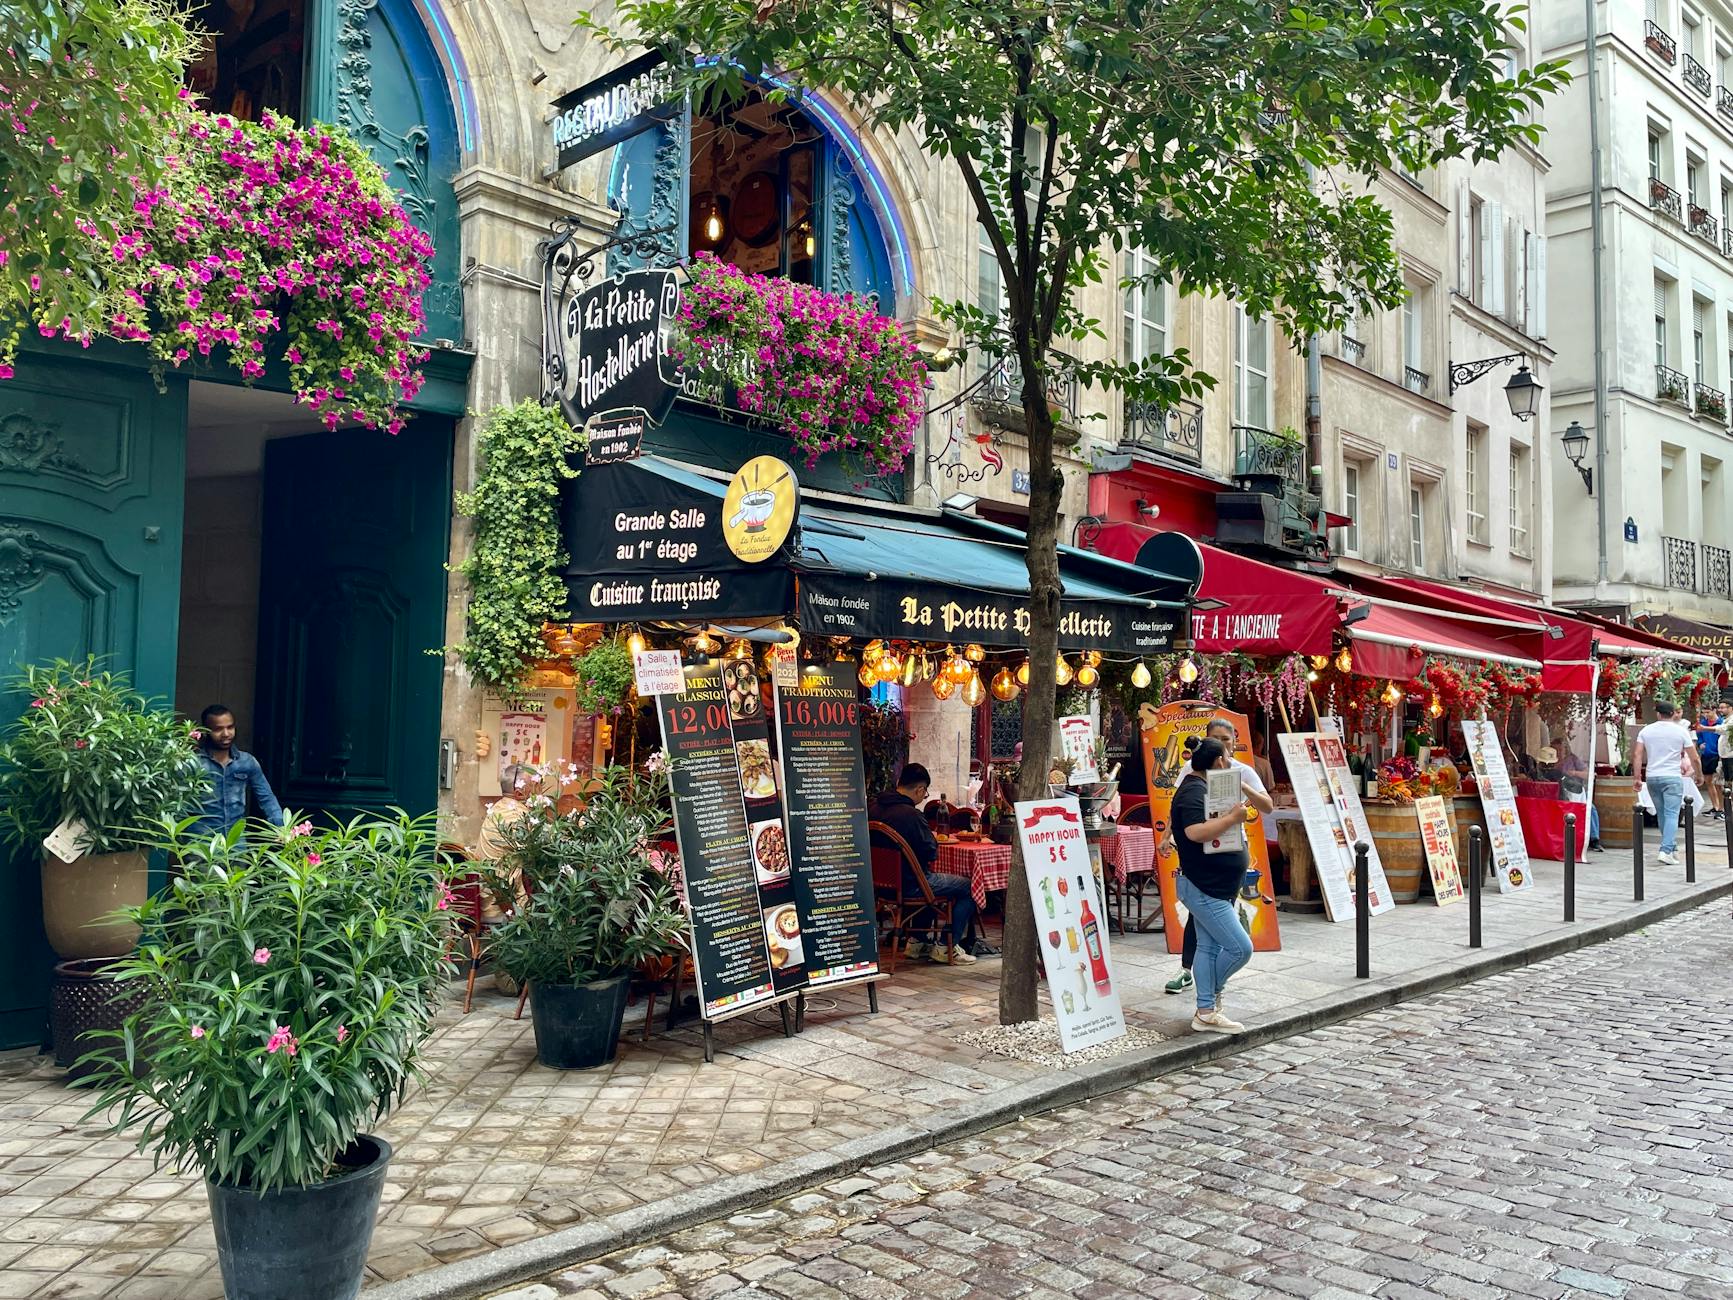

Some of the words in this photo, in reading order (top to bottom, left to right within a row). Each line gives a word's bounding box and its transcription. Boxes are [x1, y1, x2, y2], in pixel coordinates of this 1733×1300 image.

[583, 294, 603, 331] La
[605, 285, 655, 329] Petite
[579, 330, 655, 409] Hostellerie
[590, 428, 616, 441] Maison
[601, 446, 610, 454] en
[611, 441, 628, 453] 1902
[615, 511, 665, 532] Grande
[669, 508, 705, 529] Salle
[616, 543, 634, 560] au
[638, 540, 653, 560] 1er
[657, 539, 697, 563] étage
[590, 580, 644, 607] Cuisine
[650, 575, 721, 609] française
[809, 592, 839, 607] Maison
[841, 596, 870, 610] fondée
[824, 614, 834, 623] en
[836, 613, 855, 626] 1902
[900, 596, 933, 625] La
[940, 601, 1008, 632] Petite
[1013, 607, 1111, 637] Hellerie
[1131, 621, 1151, 631] Cuisine
[1152, 621, 1173, 632] française
[1212, 614, 1219, 639] A
[1226, 614, 1282, 639] L'ANCIENNE
[648, 653, 668, 663] Salle
[639, 667, 679, 678] climatisée
[644, 682, 649, 691] à
[651, 680, 678, 692] l'étage
[686, 677, 720, 689] MENU
[803, 675, 834, 686] MENU
[676, 690, 727, 702] CLASSIQU
[781, 687, 856, 698] TRADITIONNEL
[783, 700, 858, 728] 16,00€
[1172, 721, 1208, 734] Savoya
[1028, 831, 1055, 844] HAPPY
[1057, 829, 1080, 840] HOUR
[1050, 847, 1057, 863] 5
[1059, 845, 1067, 861] €
